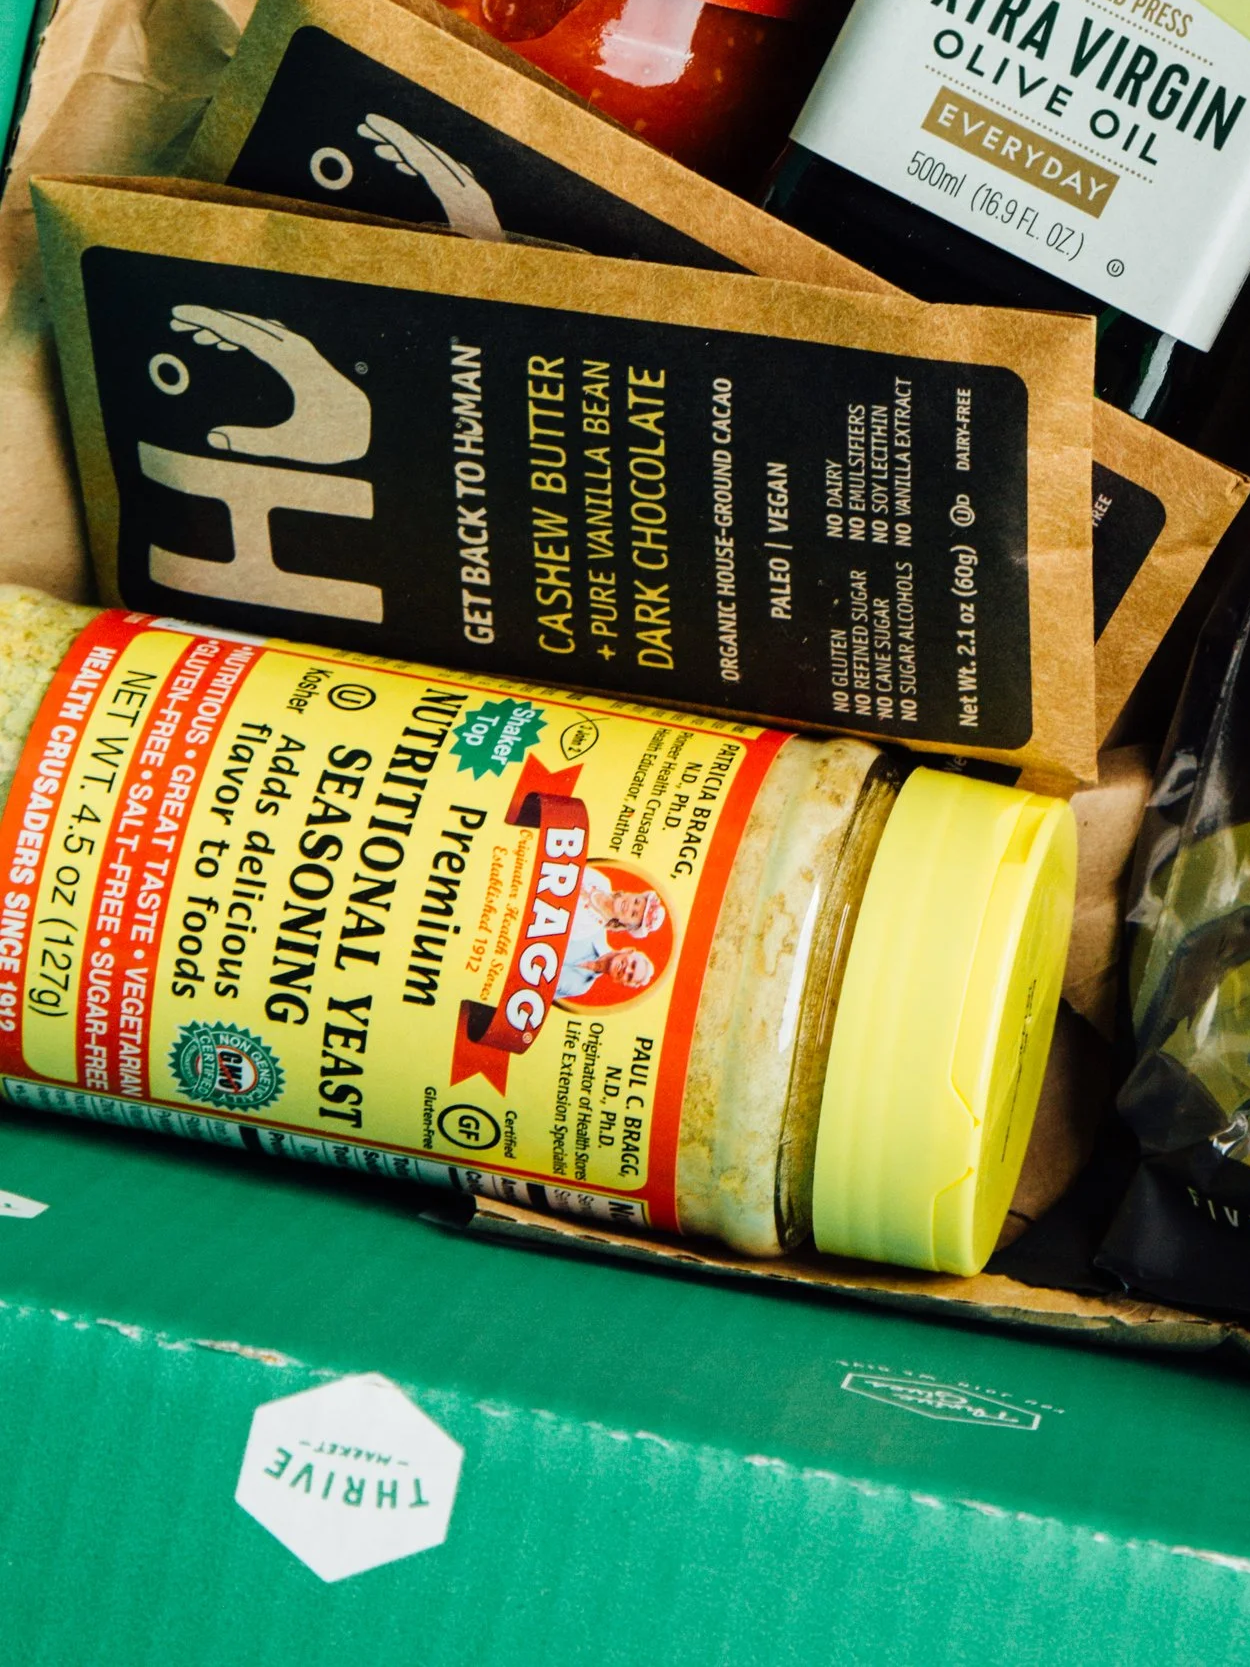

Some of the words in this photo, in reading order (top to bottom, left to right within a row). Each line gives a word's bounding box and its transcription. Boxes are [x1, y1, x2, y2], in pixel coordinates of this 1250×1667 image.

[934, 30, 1073, 117] OLIVE
[1090, 109, 1157, 165] OIL
[1070, 17, 1246, 151] VIRGIN
[938, 103, 1107, 200] EVERYDAY
[907, 151, 966, 197] 500ml
[971, 183, 1017, 223] (16.9
[1016, 207, 1049, 240] FL.
[1046, 223, 1084, 261] OZ.)
[528, 356, 566, 494] BUTTER
[583, 360, 610, 434] BEAN
[712, 378, 732, 444] CACAO
[895, 377, 911, 447] EXTRACT
[956, 389, 971, 470] DAIRY-FREE
[455, 461, 485, 498] TO
[584, 447, 614, 558] VANILLA
[628, 366, 668, 570] CHOCOLATE
[767, 463, 788, 532] VEGAN
[826, 459, 842, 508] DAIRY
[895, 452, 911, 516] VANILLA
[457, 505, 490, 585] BACK
[713, 450, 735, 596] HOUSE-GROUND
[826, 514, 843, 537] NO
[895, 523, 911, 546] NO
[462, 589, 494, 644] GET
[532, 507, 575, 653] CASHEW
[589, 570, 617, 637] PURE
[769, 558, 791, 619] PALEO
[597, 645, 615, 660] +
[634, 580, 673, 669] DARK
[718, 601, 739, 681] ORGANIC
[107, 671, 157, 727] NET
[463, 716, 500, 746] Top
[81, 738, 128, 793] WT.
[211, 723, 272, 825] flavor
[256, 735, 305, 815] Adds
[491, 708, 535, 768] Shaker
[64, 805, 101, 855] 4.5
[152, 765, 195, 852] GREAT
[334, 687, 468, 971] NUTRITIONAL
[52, 866, 80, 906] oz
[195, 840, 229, 878] to
[263, 744, 374, 1026] SEASONING
[131, 859, 169, 943] TASTE
[215, 831, 274, 998] delicious
[402, 804, 487, 1007] Premium
[506, 825, 585, 1031] BRAGG
[29, 918, 77, 1017] (127g)
[172, 897, 218, 998] foods
[318, 994, 374, 1130] YEAST
[629, 1037, 653, 1087] PAUL
[423, 1087, 436, 1149] Gluten-Free
[626, 1094, 643, 1112] C.
[619, 1117, 642, 1176] BRAGG,
[263, 1445, 430, 1510] THRIVE
